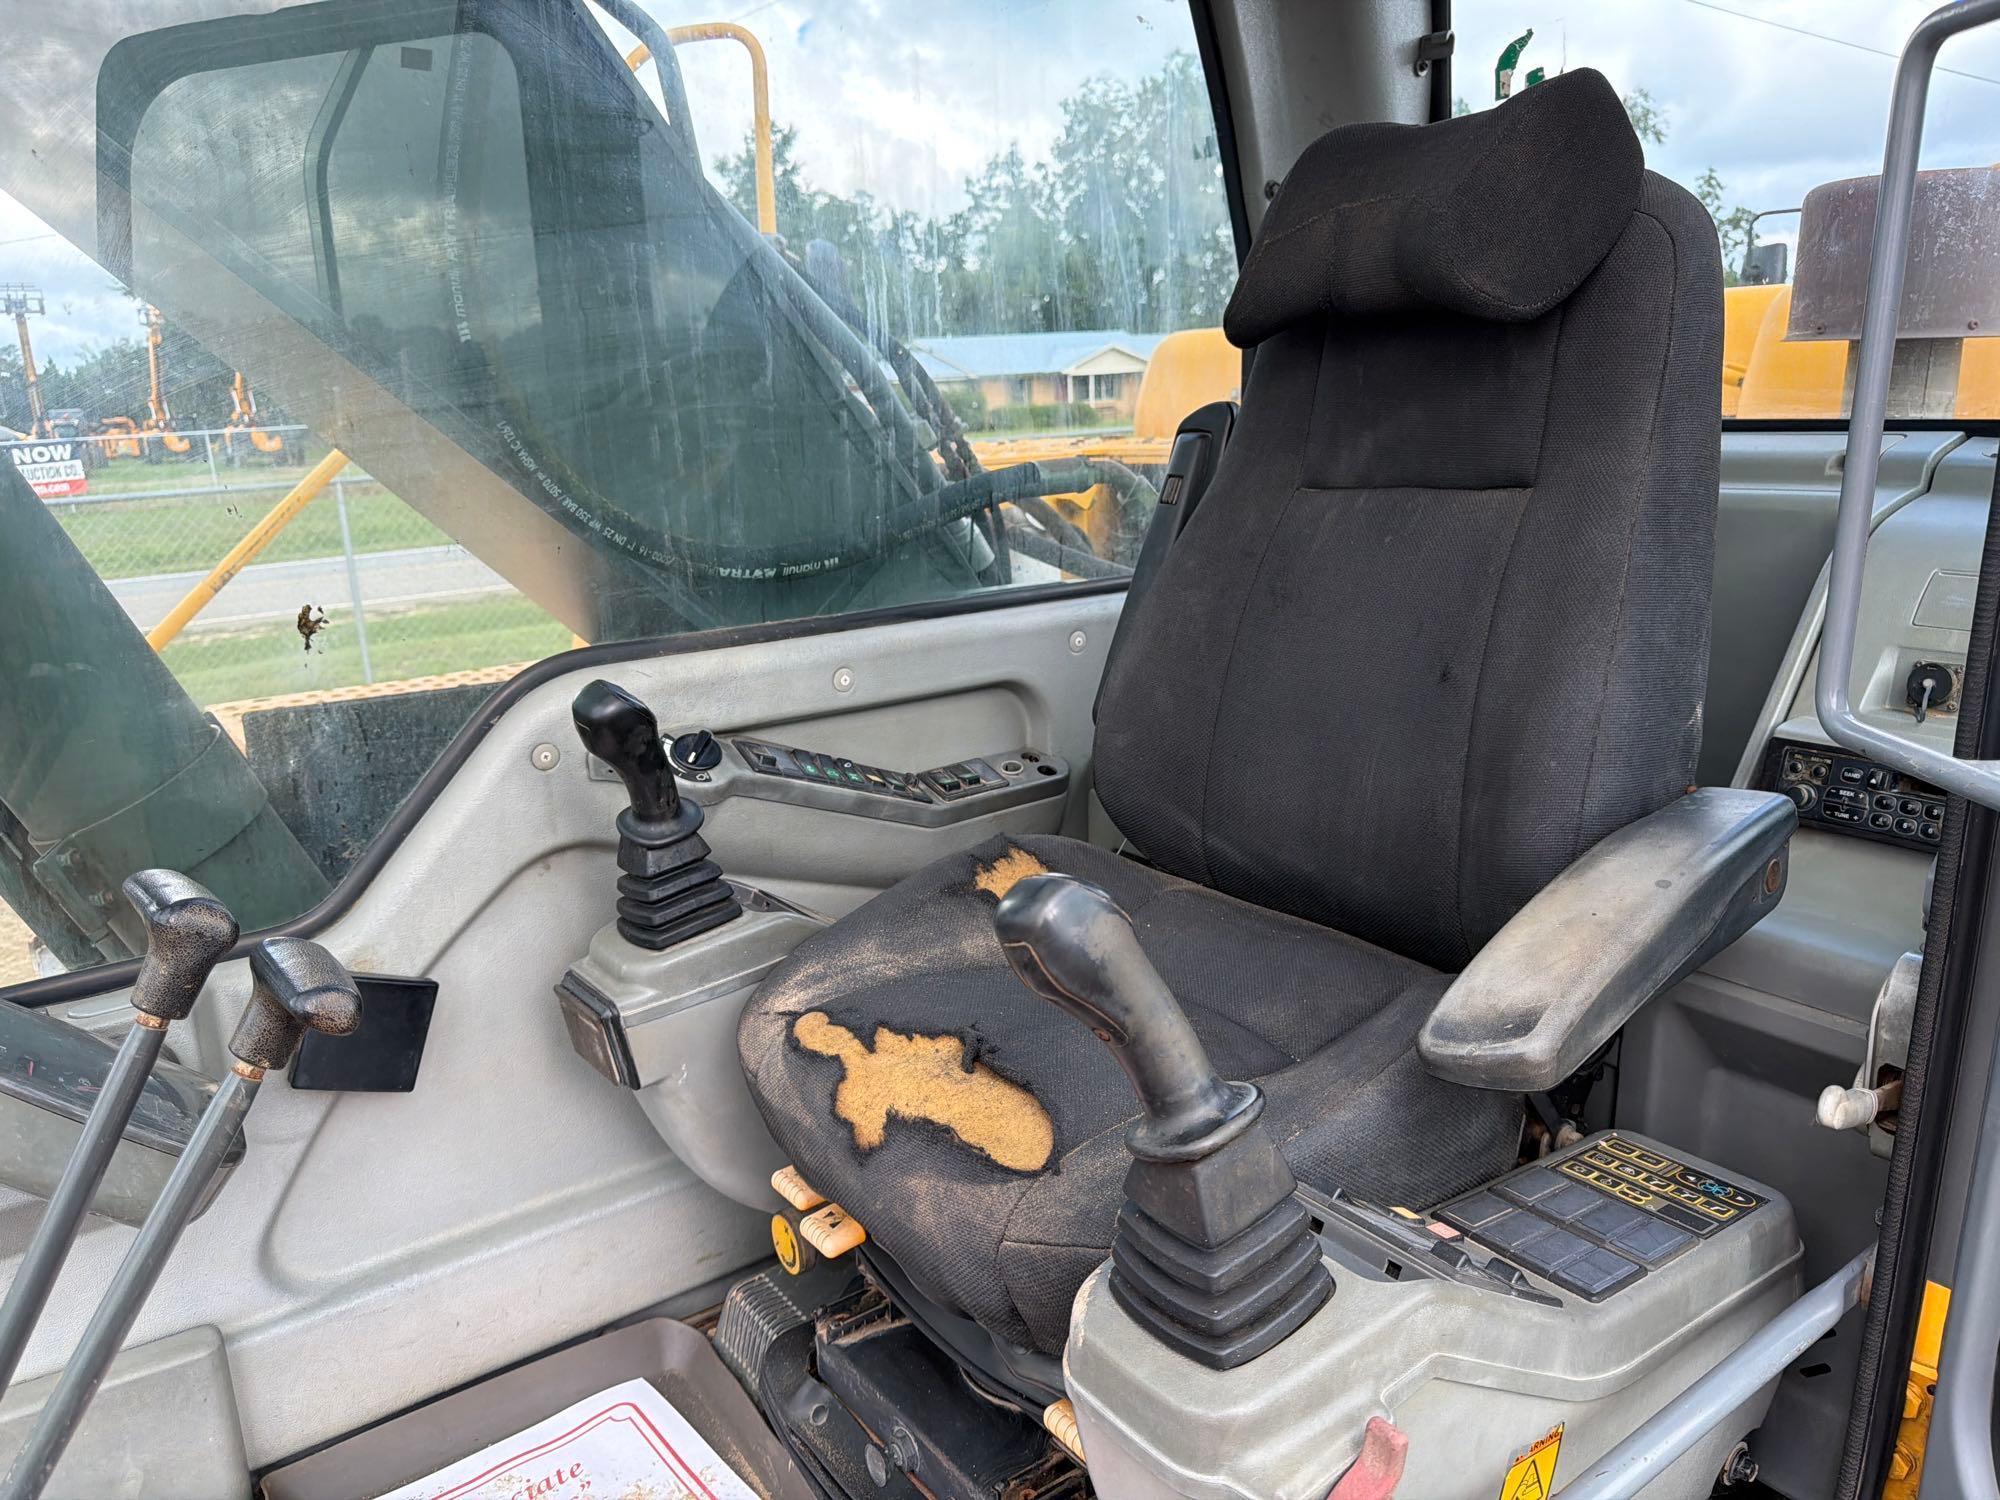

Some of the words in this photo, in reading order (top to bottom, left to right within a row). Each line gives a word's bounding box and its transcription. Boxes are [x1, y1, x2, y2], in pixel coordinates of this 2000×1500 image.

[11, 443, 72, 465] NOW
[518, 447, 539, 472] MSHA
[562, 497, 578, 513] BAR
[575, 508, 592, 523] 350
[588, 519, 602, 532] WP
[782, 561, 821, 577] manuli
[1843, 771, 1861, 779] BAND
[1838, 789, 1855, 798] SEEK
[1834, 811, 1850, 819] TUNE
